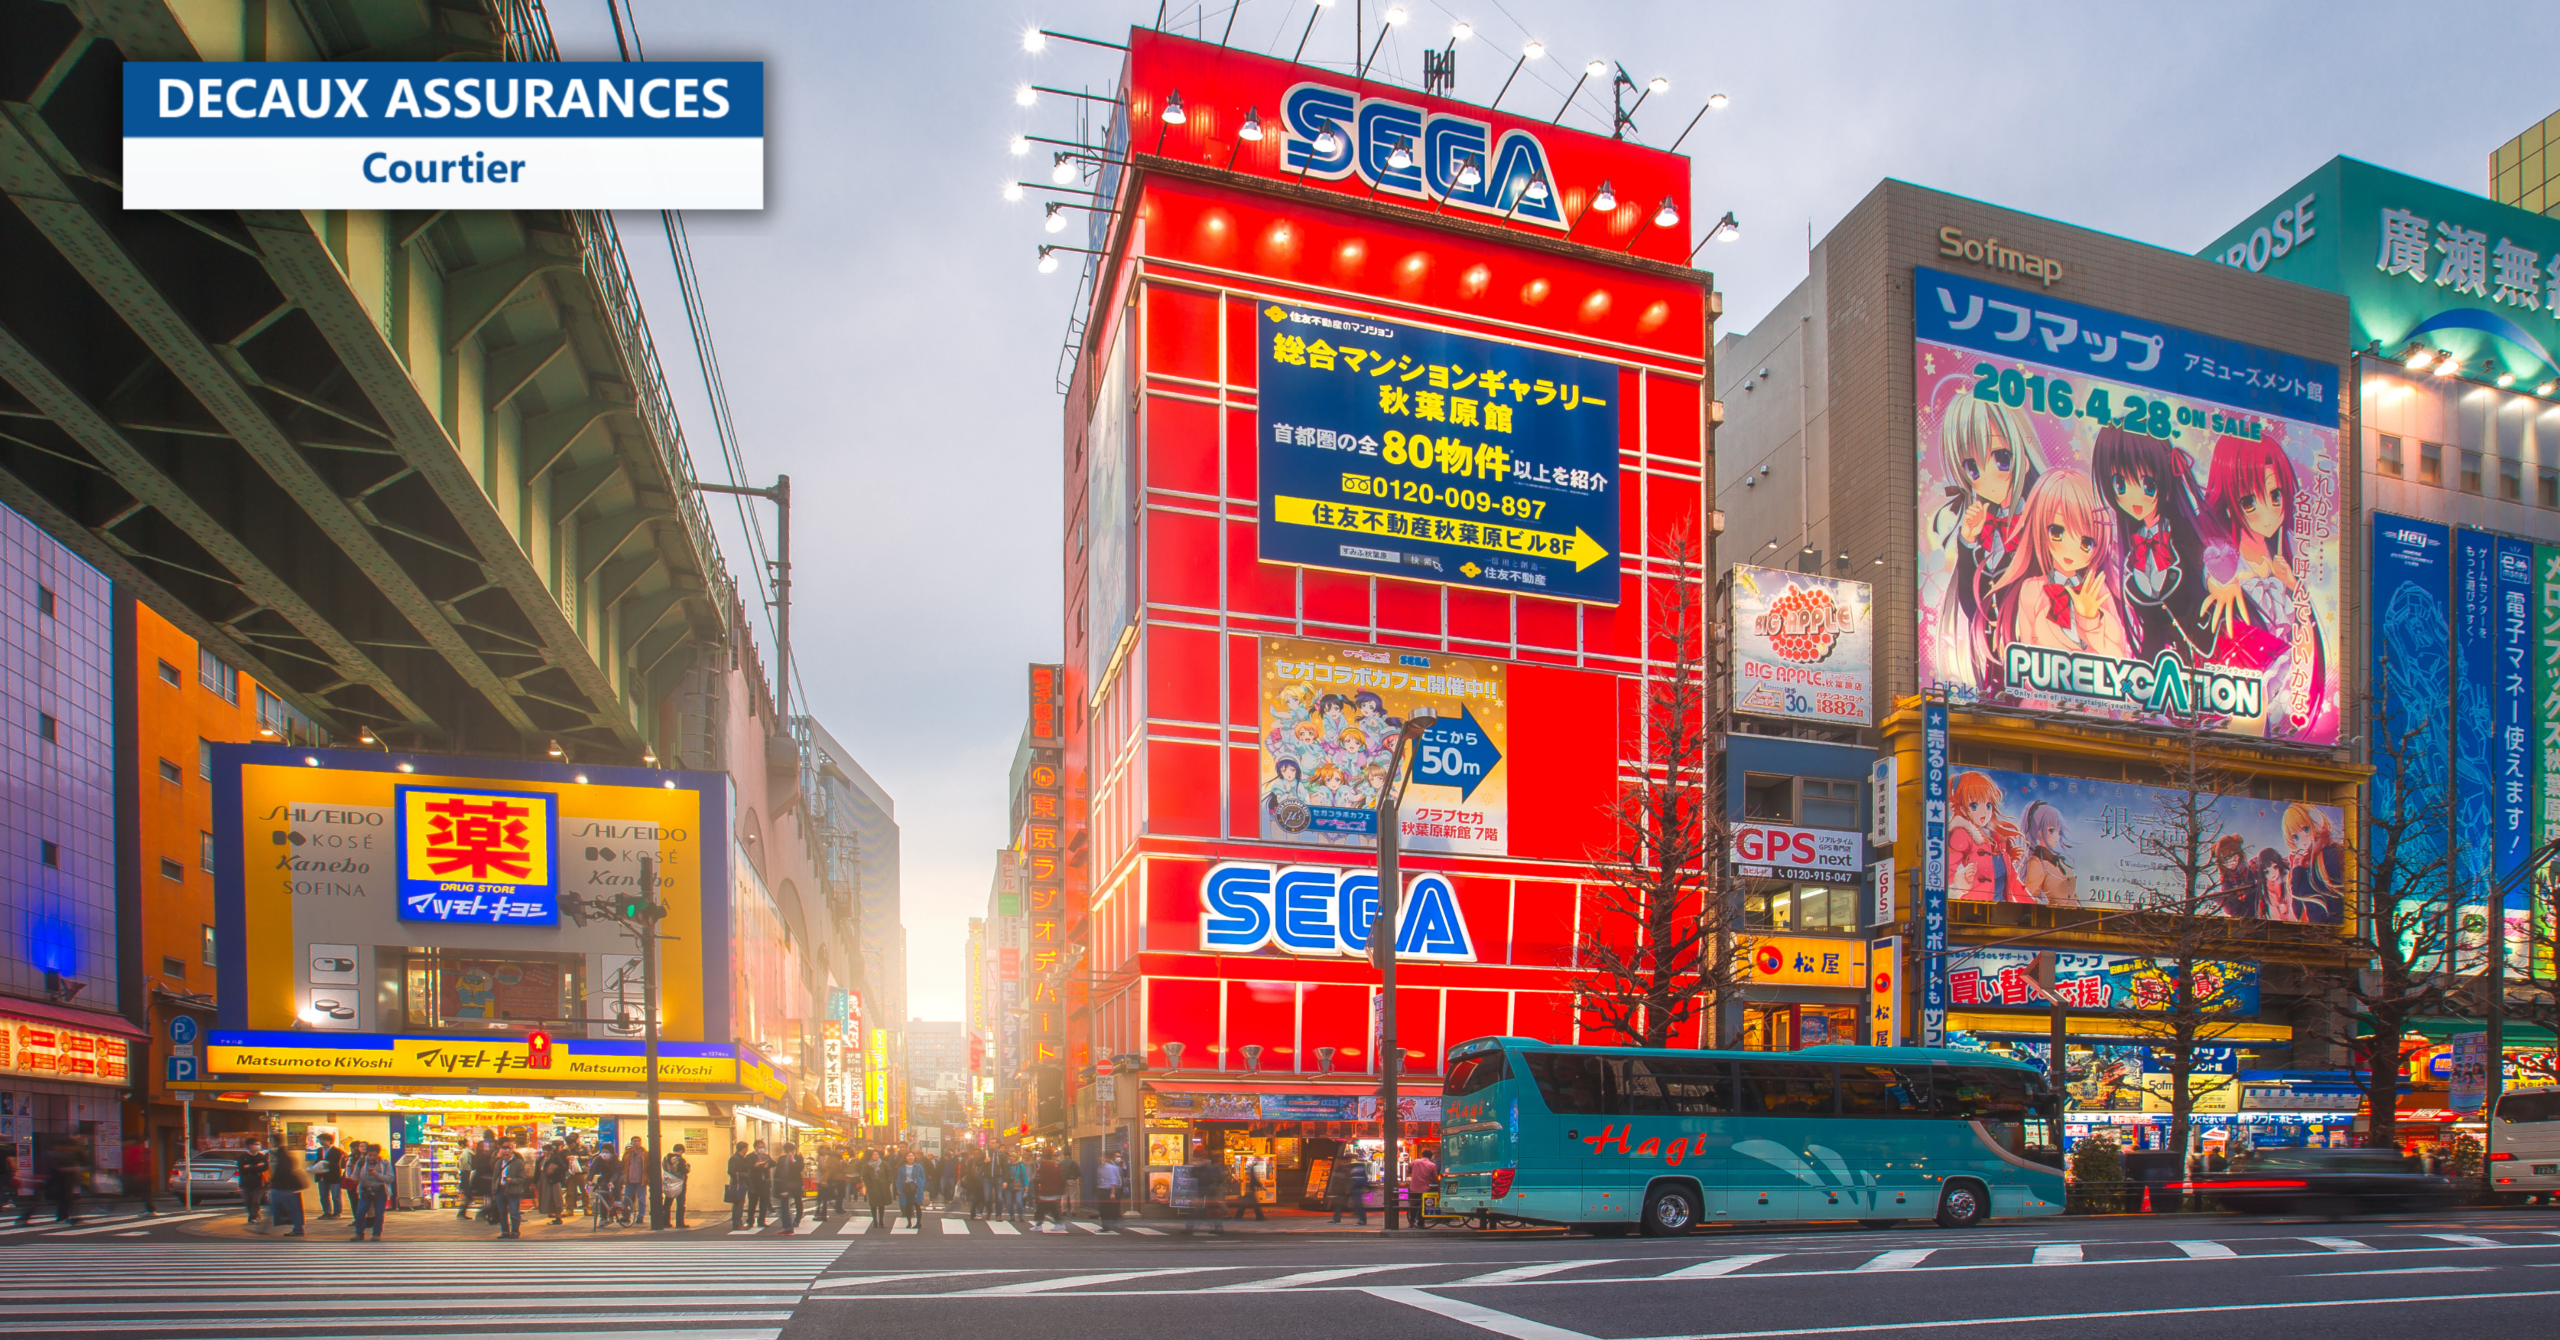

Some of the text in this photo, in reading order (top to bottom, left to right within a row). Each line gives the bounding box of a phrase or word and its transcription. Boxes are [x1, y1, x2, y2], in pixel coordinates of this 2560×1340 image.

[1280, 81, 1569, 230] SEGA
[1939, 226, 2063, 287] Sofmap
[1289, 310, 1394, 338] 住友不動産のマンション
[1936, 286, 2165, 372] ソフマップ
[1273, 332, 1606, 411] 総合マンションギャラリー
[2183, 353, 2324, 404] アミューズメント館
[1379, 385, 1513, 434] 秋葉原館
[2176, 406, 2207, 430] ON
[2211, 412, 2262, 441] SALE
[1373, 476, 1547, 521] 0120-009-897
[1312, 502, 1575, 556] 住友不動産秋葉原ビル8F
[2397, 529, 2427, 548] Hey
[1484, 567, 1547, 586] 住友不動産
[2479, 548, 2488, 639] ゲームセンターを
[1753, 603, 1855, 636] BIG APPLE
[1399, 654, 1431, 668] SEGA
[1744, 661, 1774, 680] BIG
[1825, 679, 1863, 691] 秋葉原店
[2014, 689, 2031, 699] Only
[2034, 692, 2047, 700] one
[2050, 693, 2059, 701] of
[2060, 694, 2073, 702] the
[2110, 702, 2132, 711] youth
[1421, 729, 1478, 746] ここから
[1421, 746, 1481, 776] 50m
[258, 805, 384, 827] SHISEIDO
[1313, 809, 1371, 820] セガコラボカフェ
[1415, 808, 1484, 825] クラブセガ
[425, 798, 533, 881] 薬
[572, 822, 688, 842] SHISEIDO
[1401, 821, 1498, 841] 秋葉原新館 7階
[1818, 836, 1853, 845] リアルタイム
[312, 834, 374, 850] KOSÉ
[1736, 828, 1816, 865] GPS
[275, 855, 371, 874] Kanebo
[622, 848, 679, 864] KOSÉ
[1818, 854, 1852, 866] next
[1786, 869, 1852, 883] 0120-915-047
[282, 881, 366, 897] SOFINA
[440, 882, 516, 894] DRUG STORE
[1879, 872, 1889, 911] GPS
[1926, 728, 1945, 1049] 売るのも 買うのも サポートも ソフ
[407, 892, 548, 922] マツモトキヨシ
[1200, 860, 1478, 962] SEGA
[1793, 952, 1840, 974] 松屋
[1998, 953, 2029, 961] サポートも
[974, 1003, 982, 1029] SLOT
[1875, 1004, 1890, 1047] 松屋
[175, 1023, 185, 1040] P
[848, 1020, 859, 1049] KFC
[176, 1060, 192, 1080] P
[236, 1054, 394, 1070] Matsumoto KiYoshi
[416, 1048, 552, 1074] マツモトキヨ
[569, 1061, 713, 1076] Matsumot KiYoshi
[2434, 1058, 2452, 1069] He
[2149, 1079, 2174, 1091] Sofm
[474, 1113, 493, 1121] Tax
[1446, 1099, 1485, 1120] Hagi
[1582, 1123, 1708, 1167] Hagi
